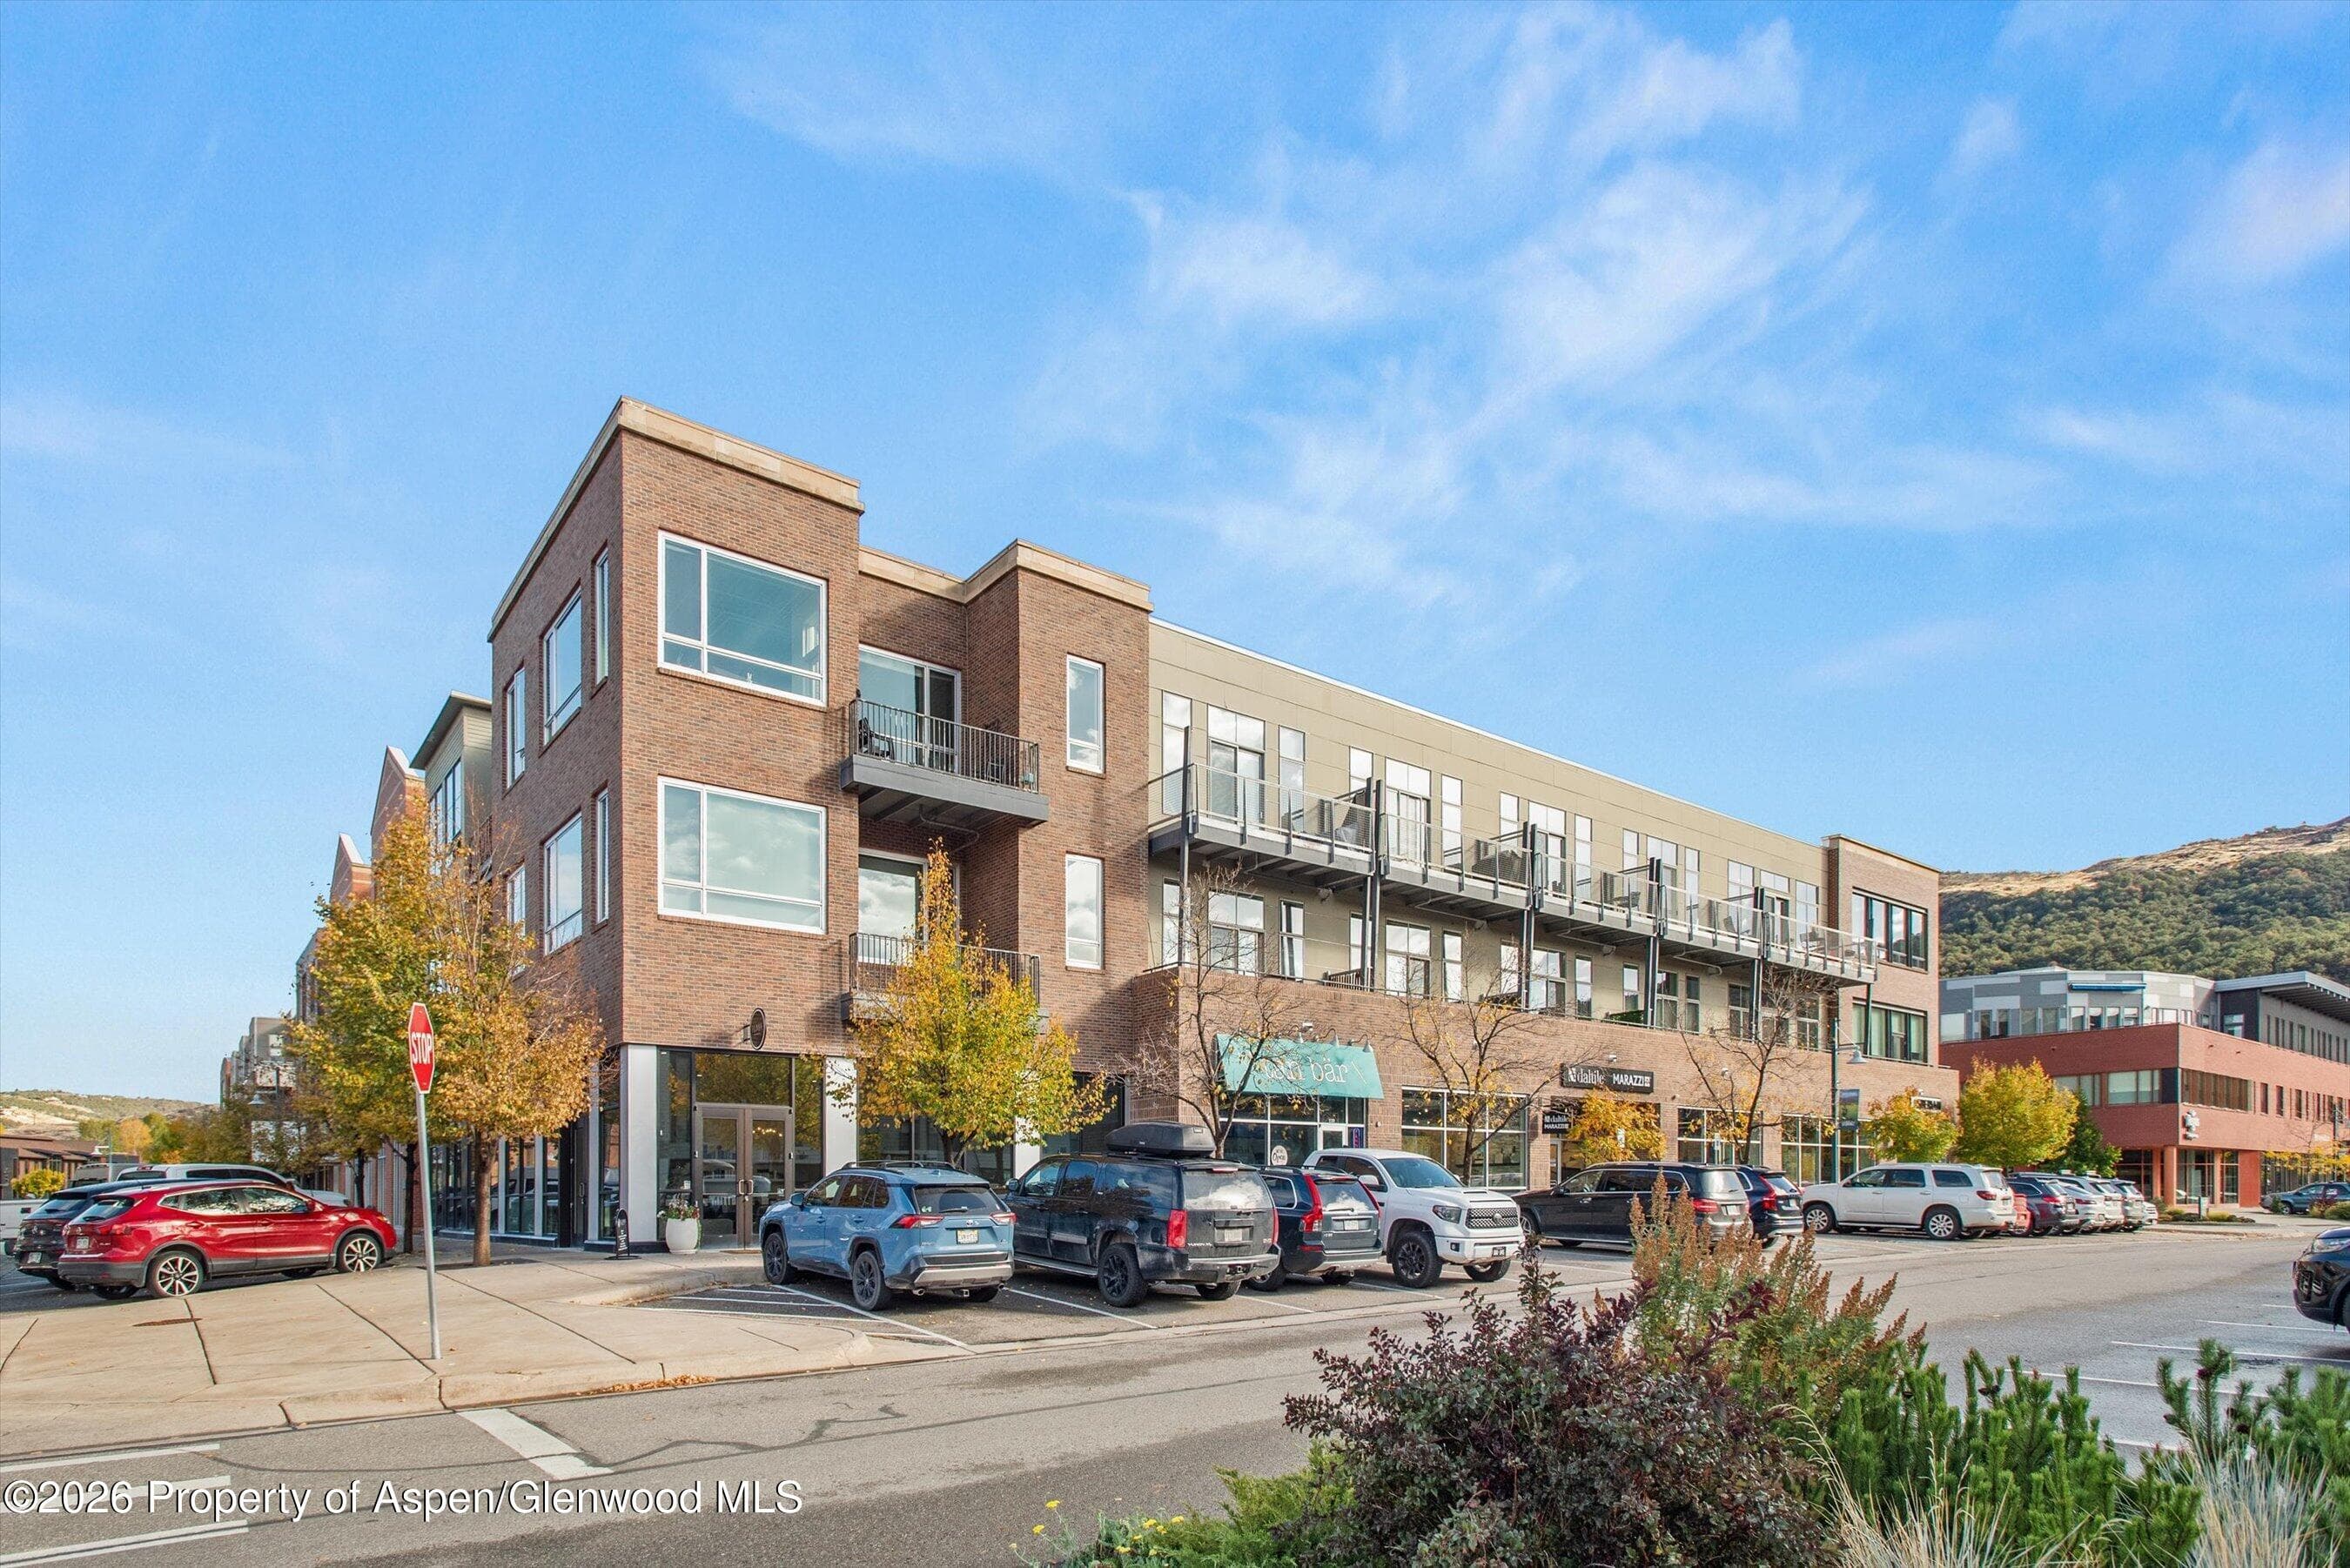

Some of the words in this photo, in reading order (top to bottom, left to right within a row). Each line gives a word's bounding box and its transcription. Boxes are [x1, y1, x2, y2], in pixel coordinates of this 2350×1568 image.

[411, 1032, 433, 1064] STOP
[1576, 1068, 1605, 1085] daltile
[1613, 1073, 1644, 1087] MARAZZI
